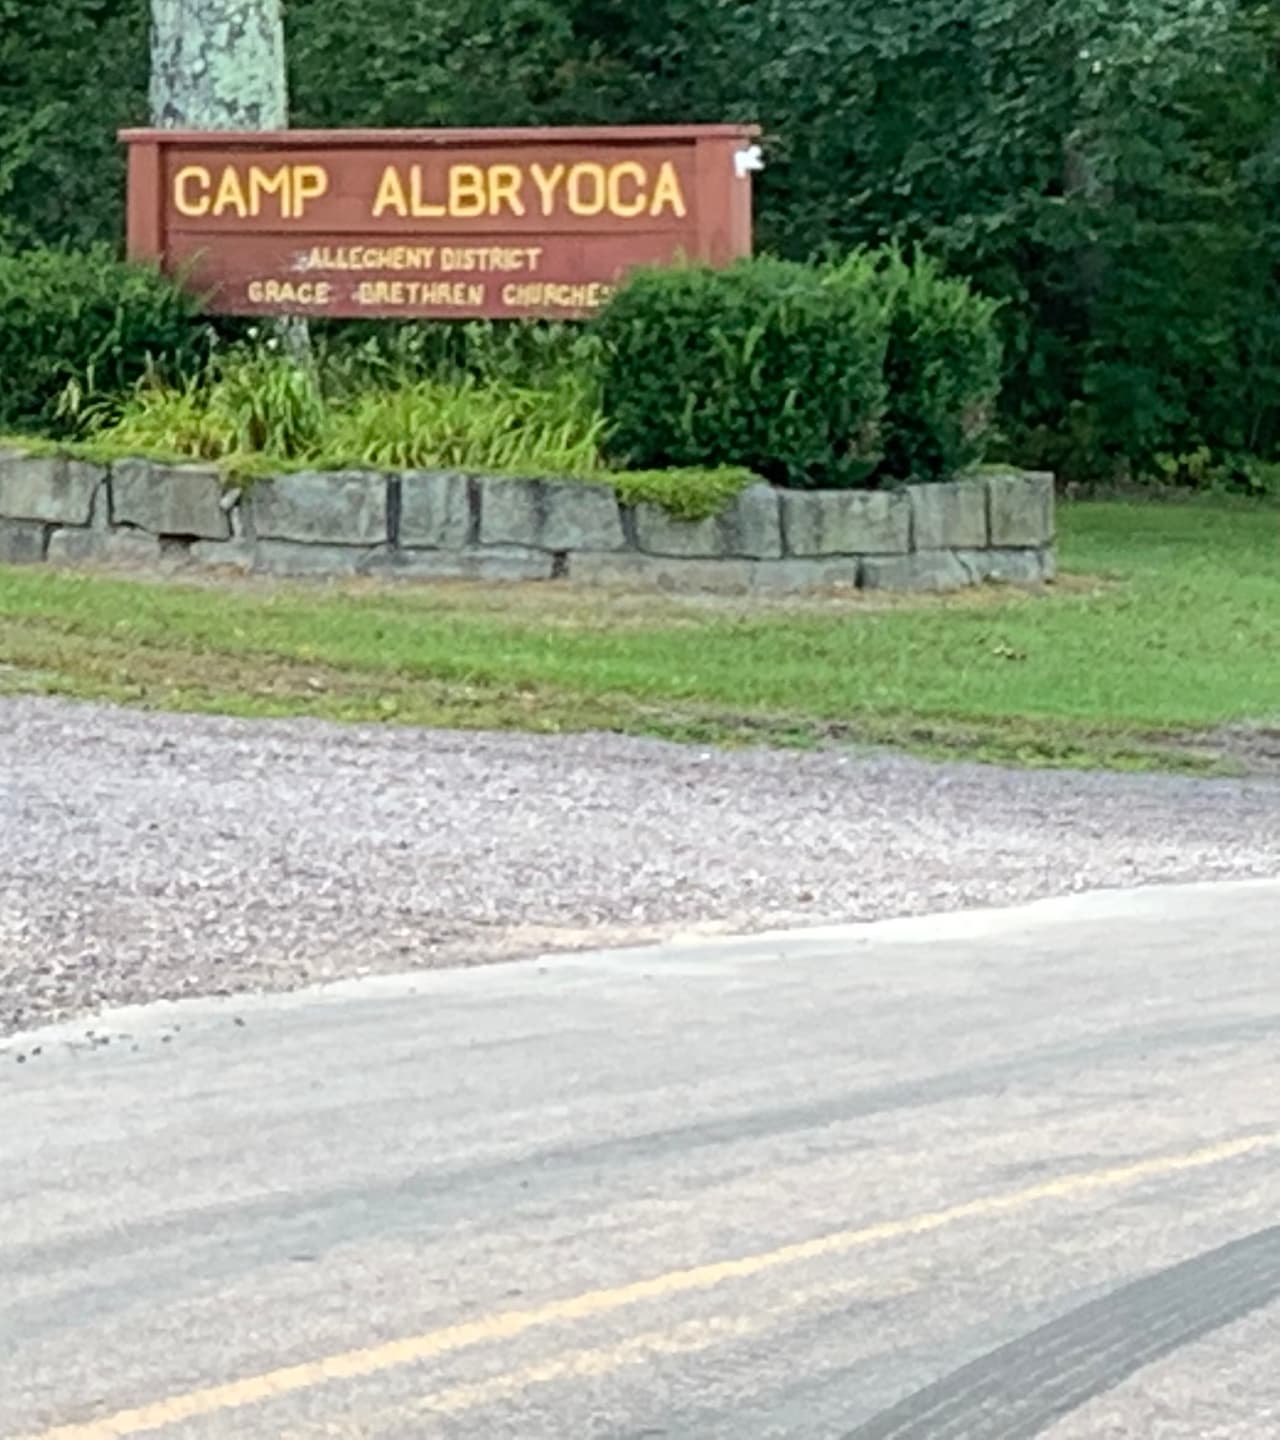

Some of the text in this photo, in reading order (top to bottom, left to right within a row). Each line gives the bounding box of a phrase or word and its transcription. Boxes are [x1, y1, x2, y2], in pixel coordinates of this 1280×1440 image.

[175, 161, 687, 218] CAMP ALBRYOCA
[440, 247, 542, 272] DISTRICT
[248, 279, 329, 305] GRACE
[359, 280, 484, 305] BRETHREN
